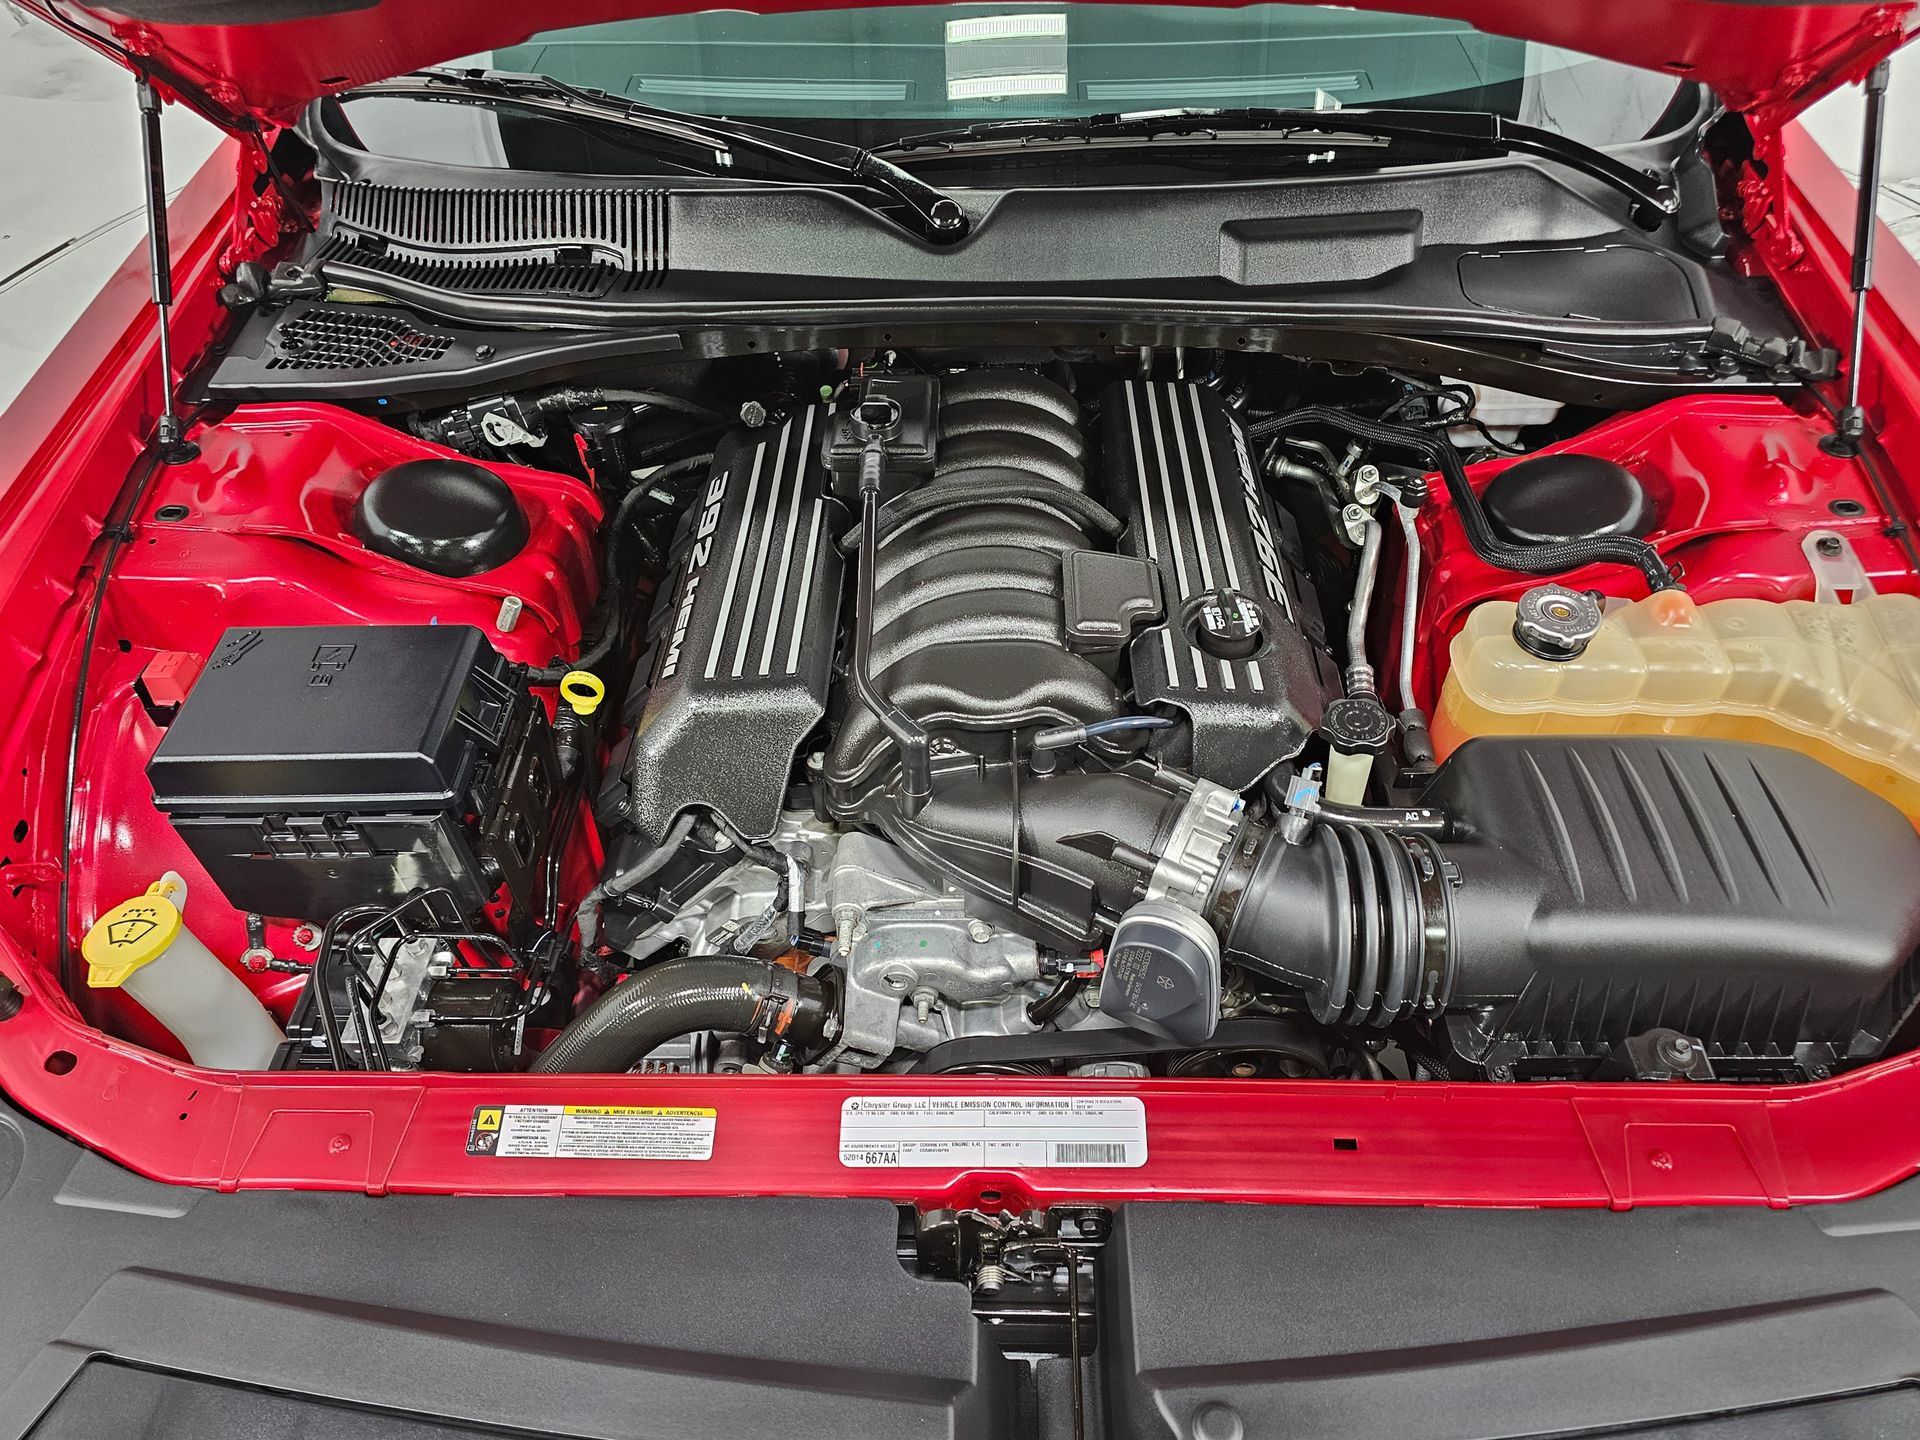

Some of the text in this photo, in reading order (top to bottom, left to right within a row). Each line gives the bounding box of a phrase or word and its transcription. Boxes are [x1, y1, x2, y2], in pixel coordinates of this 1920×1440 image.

[1229, 416, 1260, 506] HEMI
[661, 471, 729, 679] 392 HEMI
[1245, 496, 1295, 625] 392
[864, 1101, 890, 1110] Chrysler
[892, 1101, 912, 1110] Group
[994, 1101, 1023, 1109] CONTROL
[865, 1152, 896, 1164] 667AA
